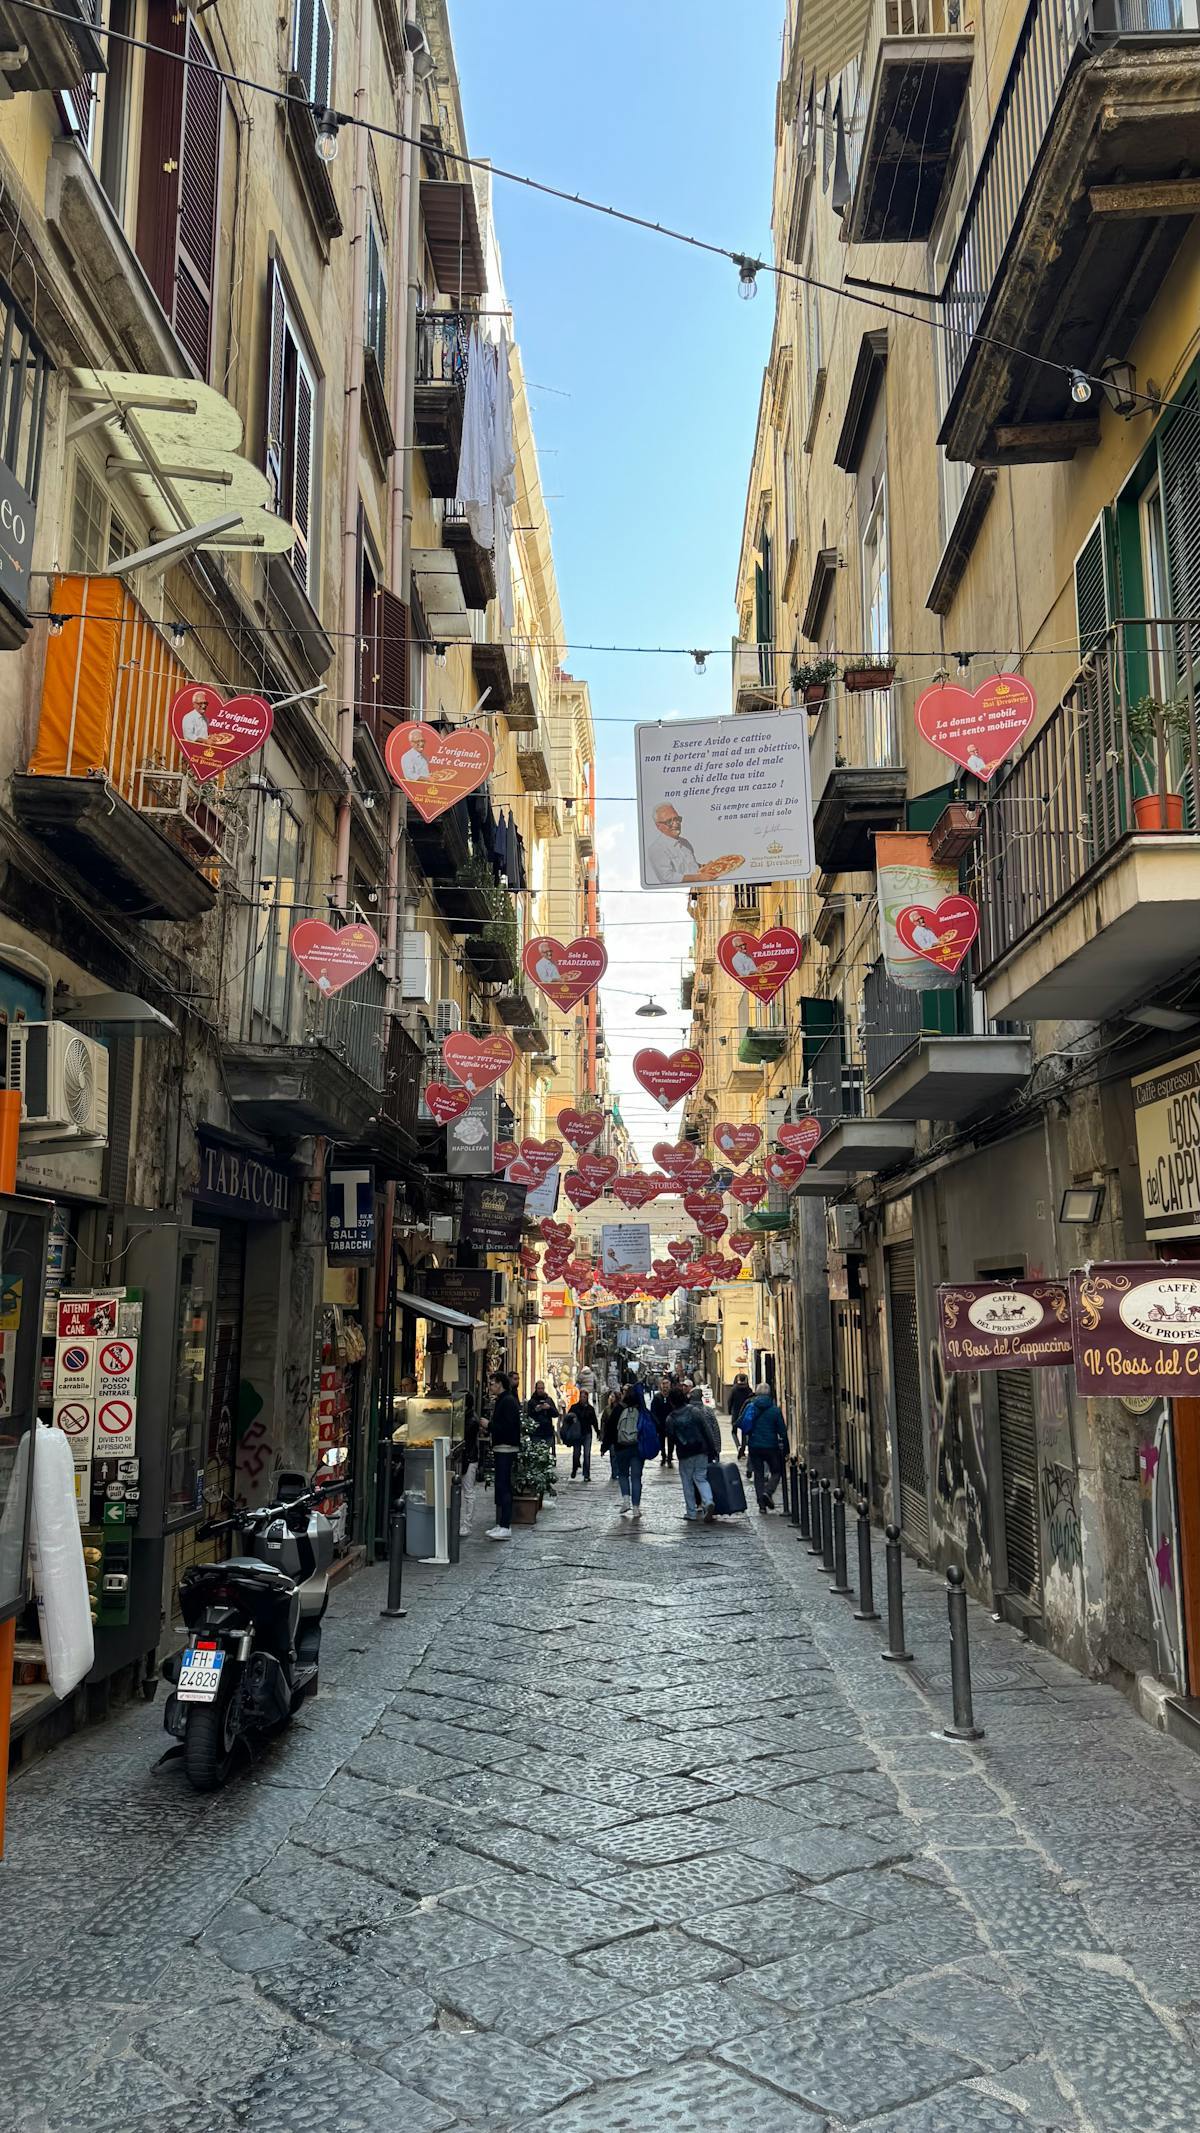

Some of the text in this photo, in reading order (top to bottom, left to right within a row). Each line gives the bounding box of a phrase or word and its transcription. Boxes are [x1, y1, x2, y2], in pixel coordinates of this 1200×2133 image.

[217, 709, 260, 726] L'originale
[936, 707, 1017, 729] La donna e' mobile
[209, 718, 263, 737] Rot'e Carrett'
[938, 731, 947, 740] io
[949, 727, 960, 738] mi
[962, 724, 985, 736] sento
[987, 718, 1027, 732] mobiliere
[672, 739, 703, 749] Essere
[704, 737, 732, 747] Avido
[741, 733, 772, 743] cattivo
[437, 746, 481, 758] L'originale
[644, 742, 801, 764] non ti portera' mai ad un obiettivo,
[429, 755, 486, 769] Rot'e Carrett'
[663, 755, 784, 773] tranne di fare solo del male
[690, 774, 704, 784] chi
[706, 771, 728, 782] della
[730, 772, 745, 781] tua
[748, 769, 765, 779] vita
[664, 779, 784, 798] non gliene frega un cazzo !
[710, 796, 799, 813] Sii sempre amico di Dio
[724, 813, 738, 821] non
[739, 810, 759, 819] sarai
[760, 809, 775, 818] mai
[776, 807, 792, 816] solo
[752, 947, 796, 958] TRADIZIONE
[557, 959, 600, 967] TRADIZIONE
[1157, 1070, 1193, 1099] espresso
[205, 1147, 289, 1211] TABACCHI
[1146, 1169, 1160, 1206] del
[330, 1170, 370, 1229] T
[333, 1230, 357, 1239] SALI
[330, 1240, 372, 1250] TABACCHI
[1158, 1281, 1198, 1294] CAFFÈ
[992, 1293, 1017, 1303] CAFFÈ
[62, 1303, 90, 1314] ATTENTI
[71, 1314, 81, 1324] AL
[976, 1316, 1038, 1332] DEL PROFESSORE
[1131, 1318, 1153, 1335] DEL
[65, 1325, 86, 1335] CANE
[948, 1337, 1073, 1361] Il Boss del Cappuccino
[1084, 1348, 1104, 1376] Il
[1105, 1347, 1153, 1376] Boss
[1154, 1349, 1183, 1375] del
[109, 1490, 122, 1498] pull
[192, 1651, 209, 1666] FH
[180, 1670, 219, 1688] 24828
